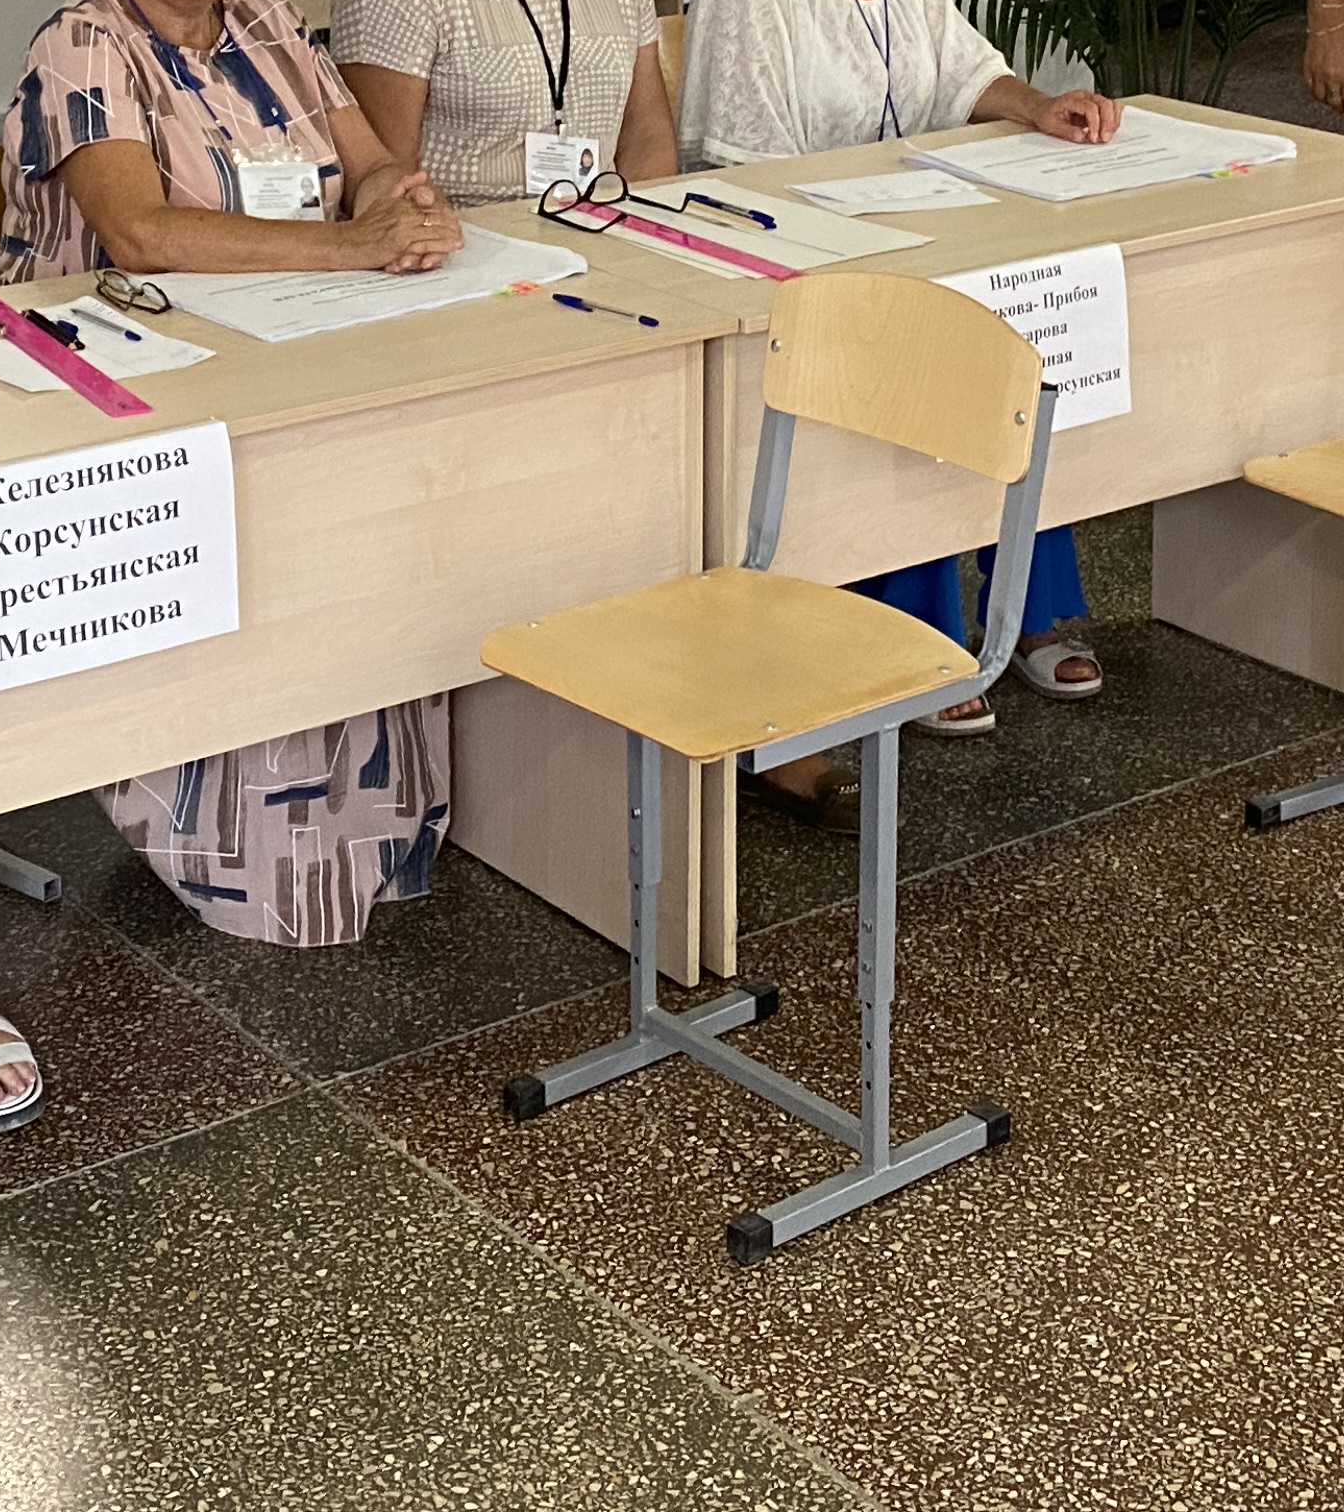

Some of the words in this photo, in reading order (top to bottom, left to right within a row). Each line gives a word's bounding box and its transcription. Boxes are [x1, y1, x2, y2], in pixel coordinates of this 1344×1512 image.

[989, 264, 1062, 291] Народная
[1043, 285, 1098, 310] Прибоя
[1022, 322, 1068, 344] арова
[1056, 368, 1121, 398] рсунская
